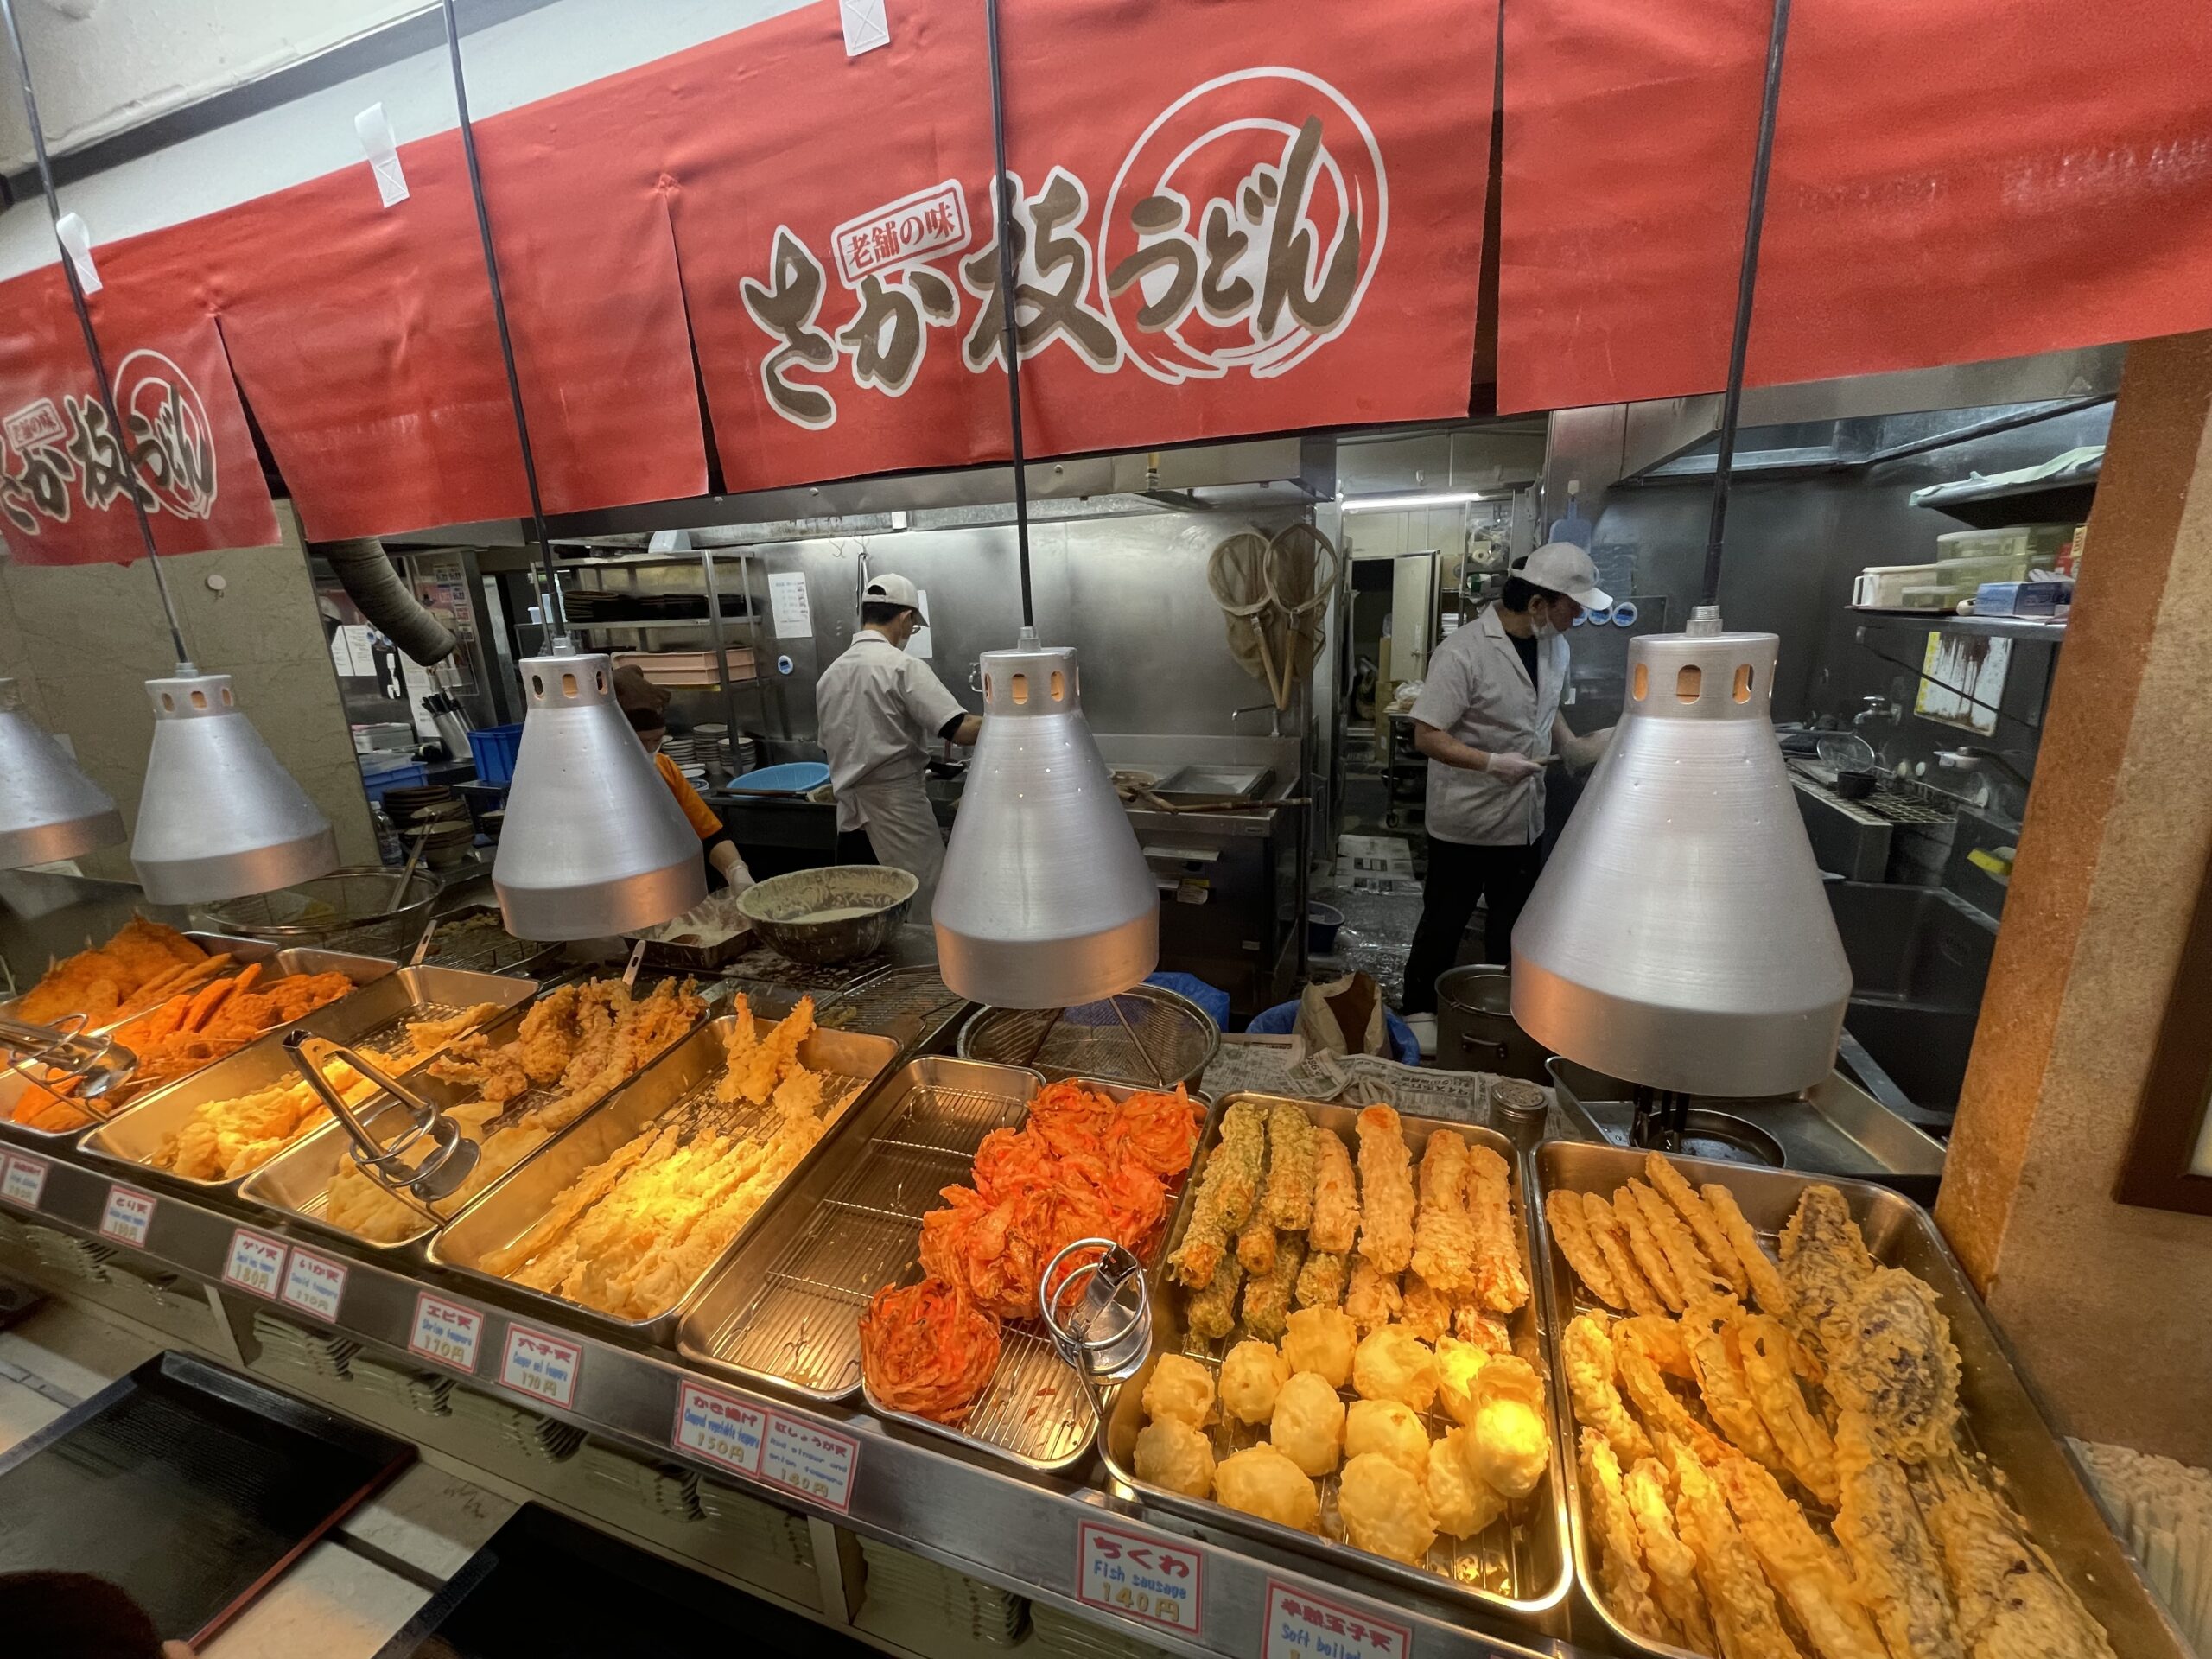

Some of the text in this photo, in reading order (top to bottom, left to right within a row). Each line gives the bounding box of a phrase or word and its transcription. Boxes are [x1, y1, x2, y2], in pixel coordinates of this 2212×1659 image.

[845, 200, 956, 270] 老舗の味
[300, 1260, 339, 1282] いか天
[427, 1305, 472, 1329] エビ天
[424, 1335, 464, 1363] 170円
[518, 1338, 571, 1363] 穴子天
[522, 1372, 556, 1396] 170円
[698, 1433, 744, 1463] 150円
[1093, 1536, 1189, 1578] ちくわ
[1094, 1560, 1186, 1599] Fish sausage
[1103, 1582, 1179, 1623] 140円
[1281, 1599, 1392, 1652] 半熟玉子天
[1281, 1623, 1310, 1648] Soft
